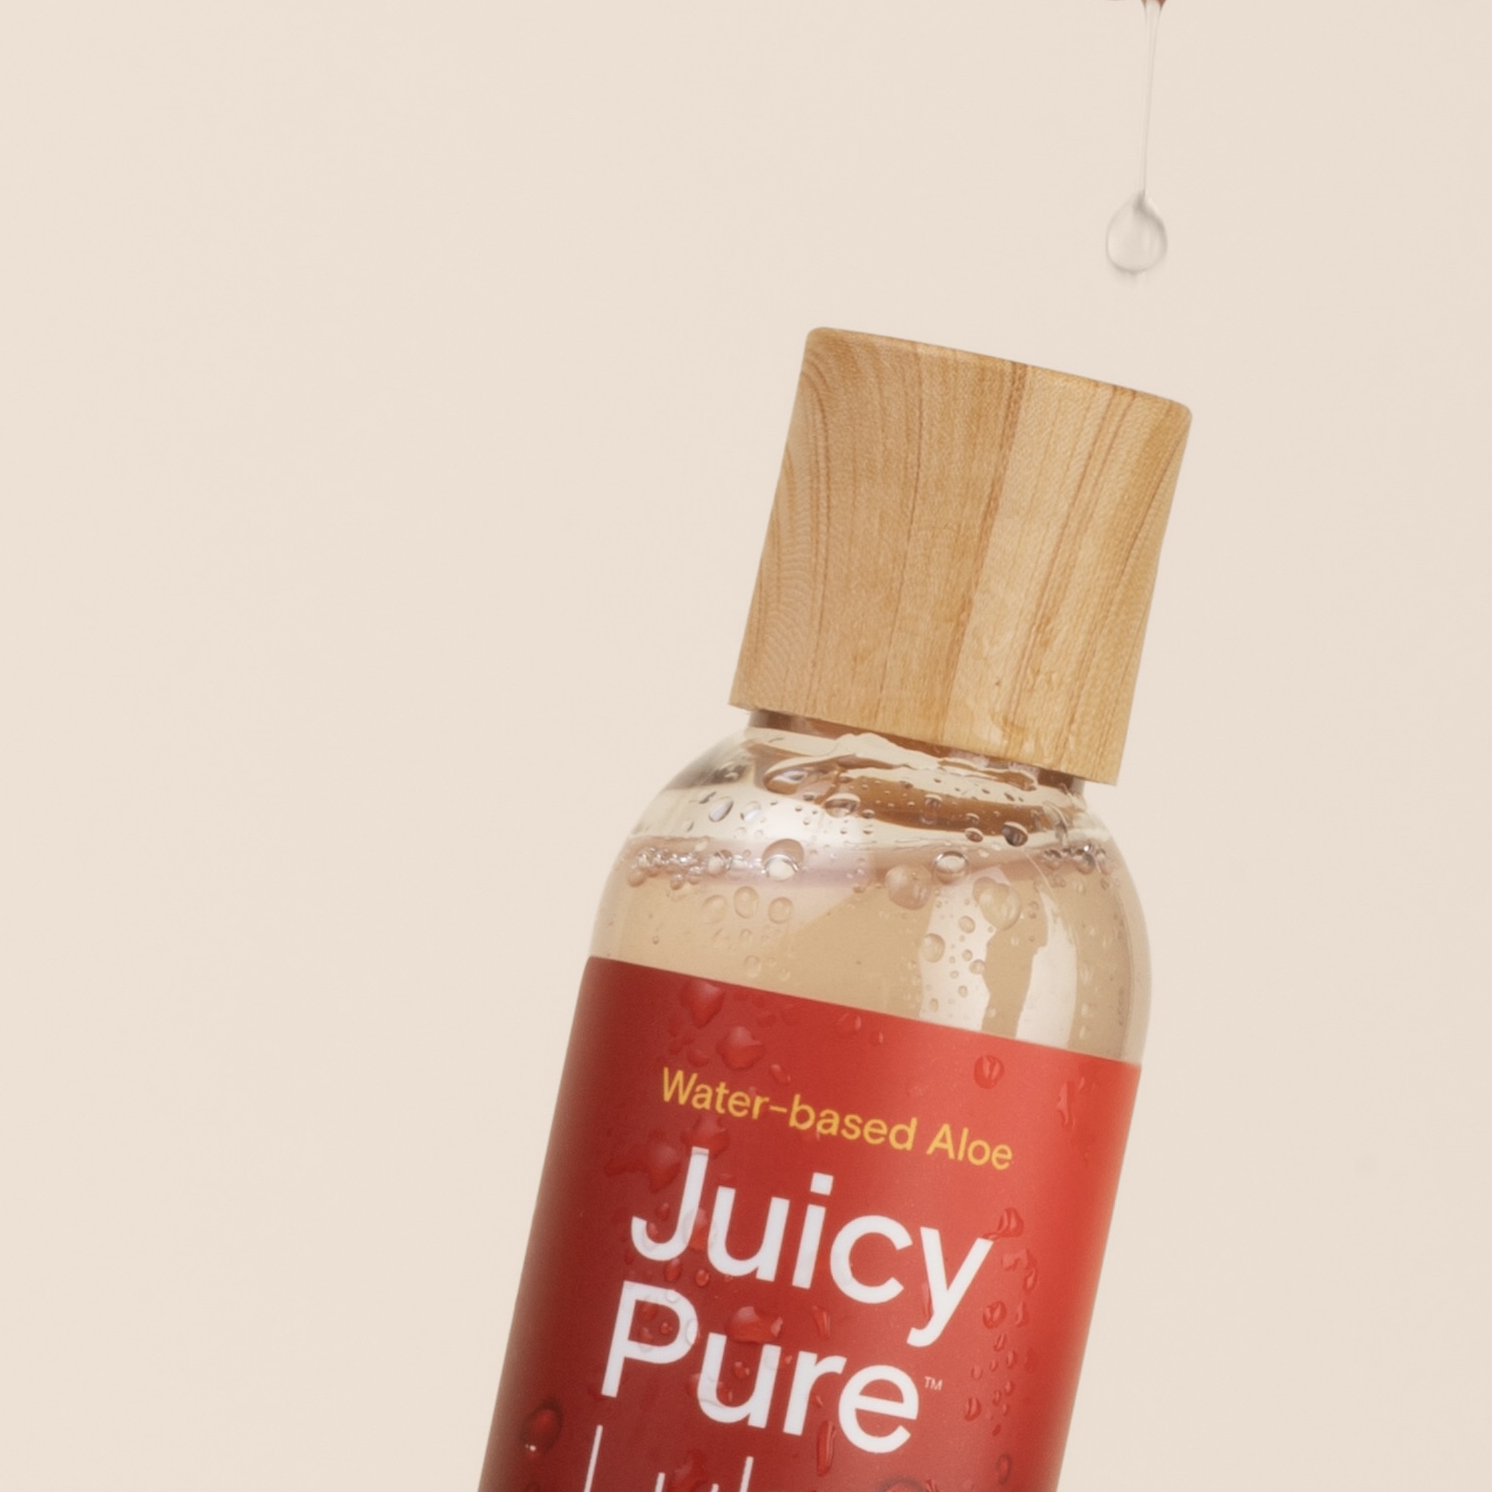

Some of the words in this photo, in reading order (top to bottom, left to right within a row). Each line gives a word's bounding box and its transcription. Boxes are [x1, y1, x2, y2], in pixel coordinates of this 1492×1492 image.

[662, 1067, 917, 1151] Water-based
[927, 1123, 1014, 1170] Aloe
[630, 1146, 994, 1348] Juicy
